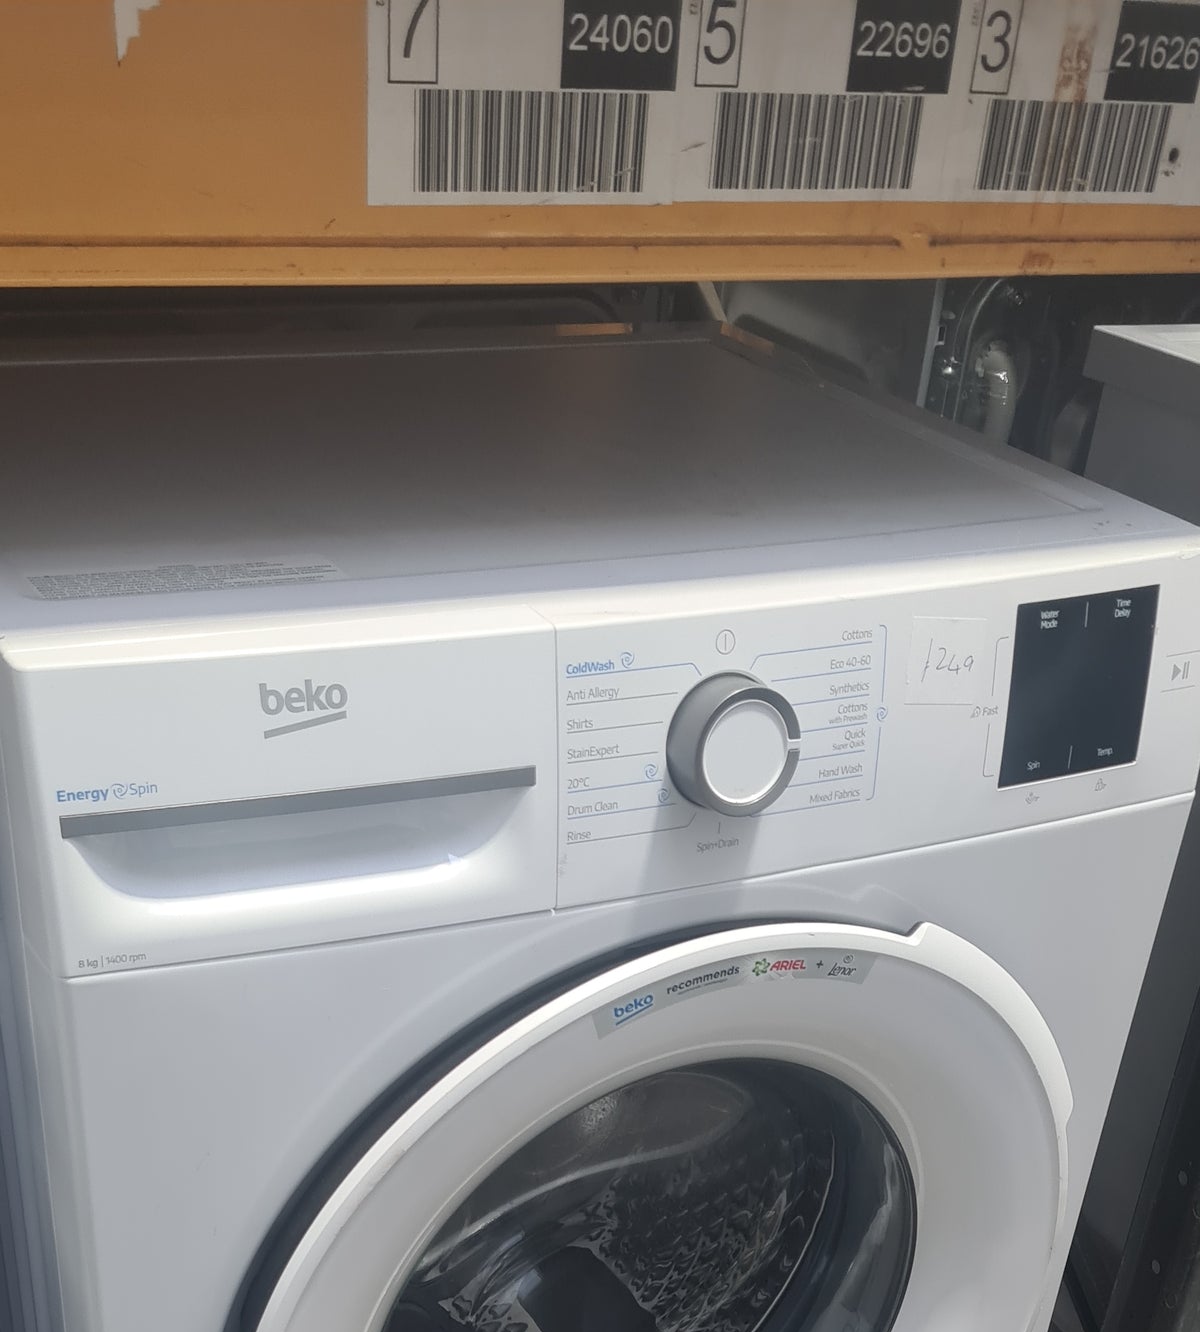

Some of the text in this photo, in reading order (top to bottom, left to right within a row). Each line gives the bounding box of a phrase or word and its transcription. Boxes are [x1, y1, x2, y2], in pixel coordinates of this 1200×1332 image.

[568, 14, 674, 54] 24060
[703, 0, 737, 65] 5
[857, 22, 952, 58] 22696
[981, 10, 1012, 73] 3
[1116, 33, 1200, 70] 21626
[1116, 598, 1132, 608] Time
[1114, 607, 1132, 619] Delay
[1040, 618, 1059, 630] Mode
[841, 629, 873, 642] Cottons
[566, 660, 615, 674] ColdWash
[830, 654, 872, 670] Eco 40-60
[259, 679, 348, 716] beko
[566, 686, 620, 702] Anti Allergy
[829, 682, 870, 697] Synthetics
[837, 702, 868, 714] Cottons
[982, 704, 999, 716] Fast
[566, 718, 594, 731] Shirts
[844, 728, 866, 741] Quick
[566, 744, 620, 760] StainExpert
[818, 763, 863, 778] Hand Wash
[1027, 760, 1041, 771] Spin
[57, 781, 159, 803] Energy Spin
[809, 788, 861, 805] Mixed Fabrics
[567, 800, 618, 816] Drum Clean
[567, 830, 592, 841] Rinse
[78, 952, 147, 969] 8 kg 1400 rpm
[614, 994, 654, 1018] beko
[666, 966, 740, 995] recommends
[770, 959, 807, 972] ARIEL
